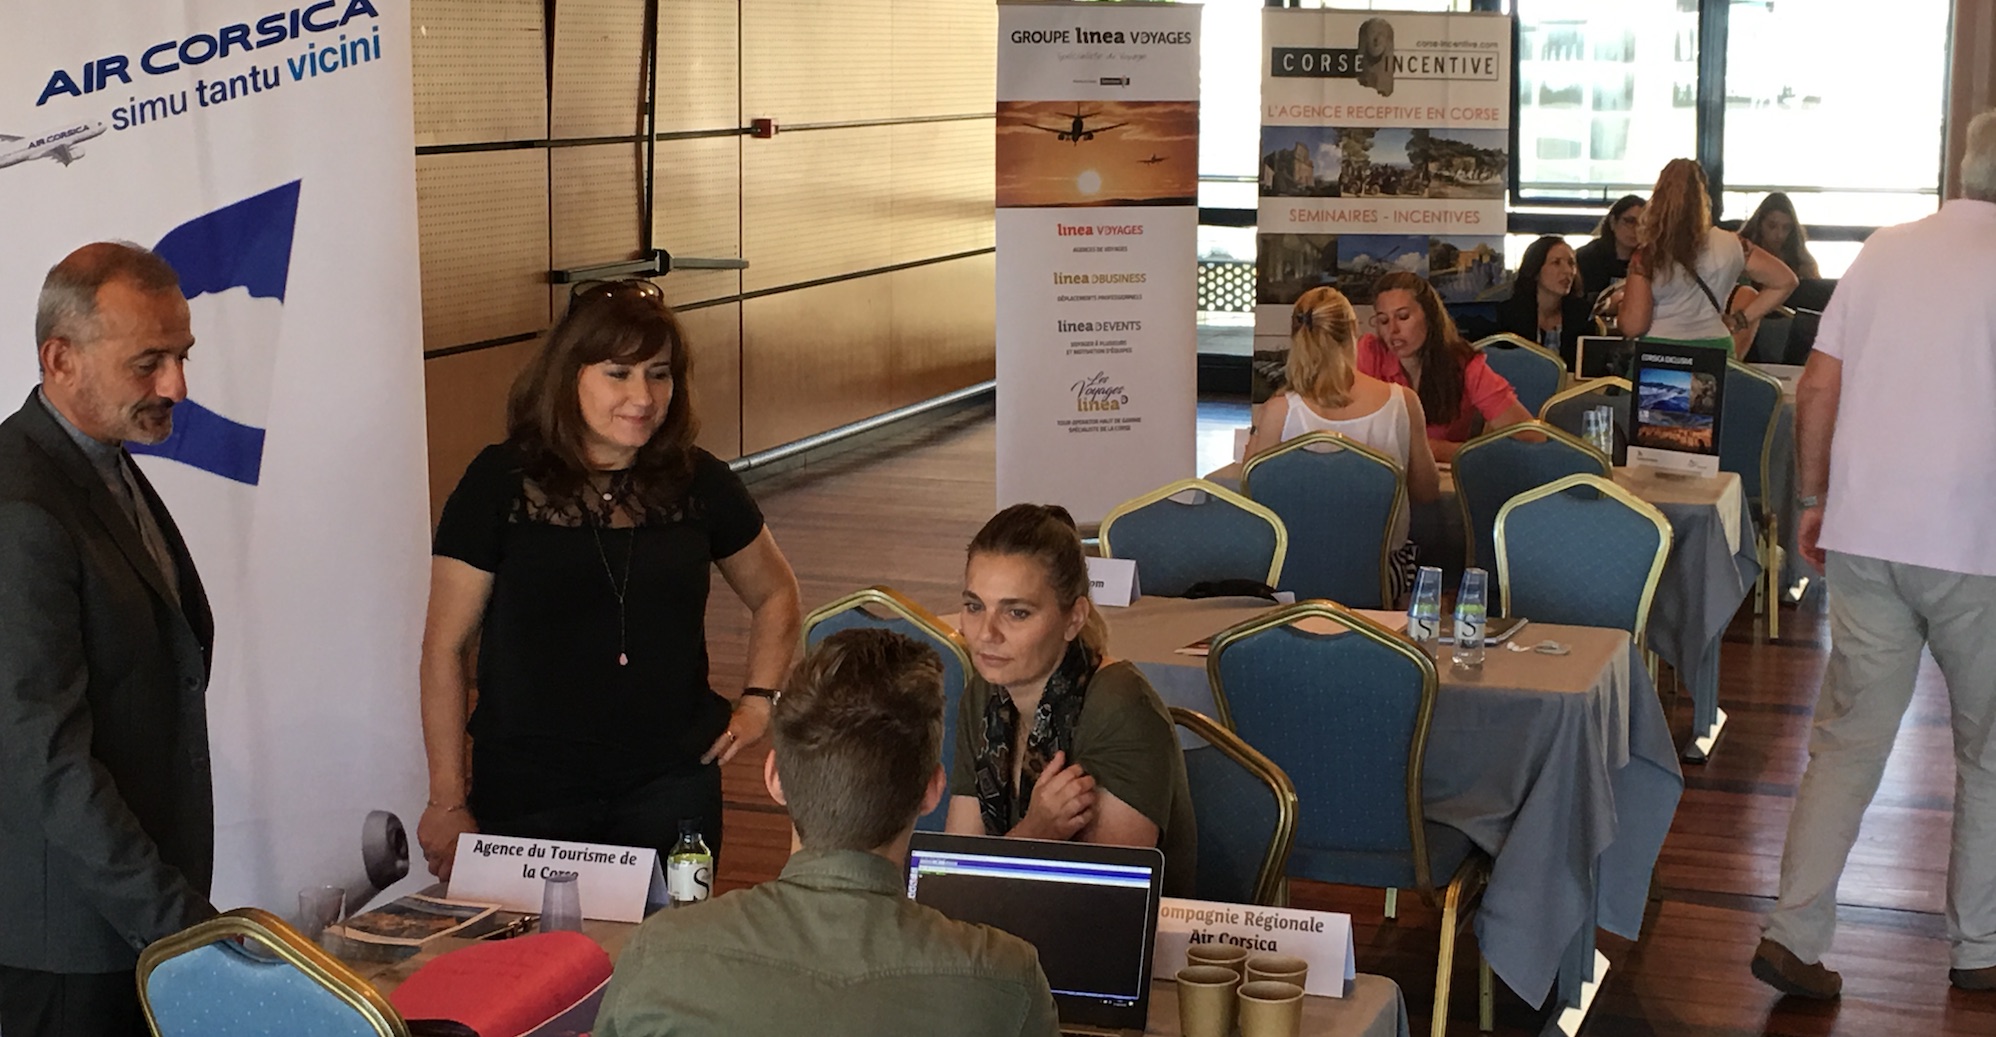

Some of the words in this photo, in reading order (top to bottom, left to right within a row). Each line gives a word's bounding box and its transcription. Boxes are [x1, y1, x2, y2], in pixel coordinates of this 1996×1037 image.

[1011, 30, 1070, 44] GROUPE
[35, 55, 132, 107] AIR
[140, 0, 379, 75] CORSICA
[1283, 53, 1364, 73] CORSE
[1384, 55, 1493, 75] INCENTIVE
[111, 91, 188, 131] simu
[196, 65, 280, 108] tantu
[287, 26, 381, 82] vicini
[1267, 105, 1342, 119] L'AGENCE
[1347, 106, 1421, 119] RECEPTIVE
[1427, 107, 1445, 120] EN
[1451, 107, 1499, 121] CORSE
[28, 138, 46, 149] AIR
[46, 125, 90, 143] CORSICA
[1289, 209, 1377, 223] SEMINAIRES
[1394, 210, 1480, 224] INCENTIVES
[1053, 272, 1089, 285] linea
[1057, 320, 1093, 332] linea
[1087, 371, 1109, 387] Les
[1071, 380, 1124, 402] Voyages
[1077, 398, 1120, 412] linea
[473, 839, 524, 857] Agence
[528, 844, 545, 859] du
[551, 846, 616, 864] Tourisme
[620, 850, 637, 866] de
[523, 864, 536, 879] la
[1161, 904, 1239, 926] ompagnie
[1244, 911, 1324, 933] Régionale
[1189, 929, 1214, 944] Air
[1219, 931, 1278, 952] Corsica
